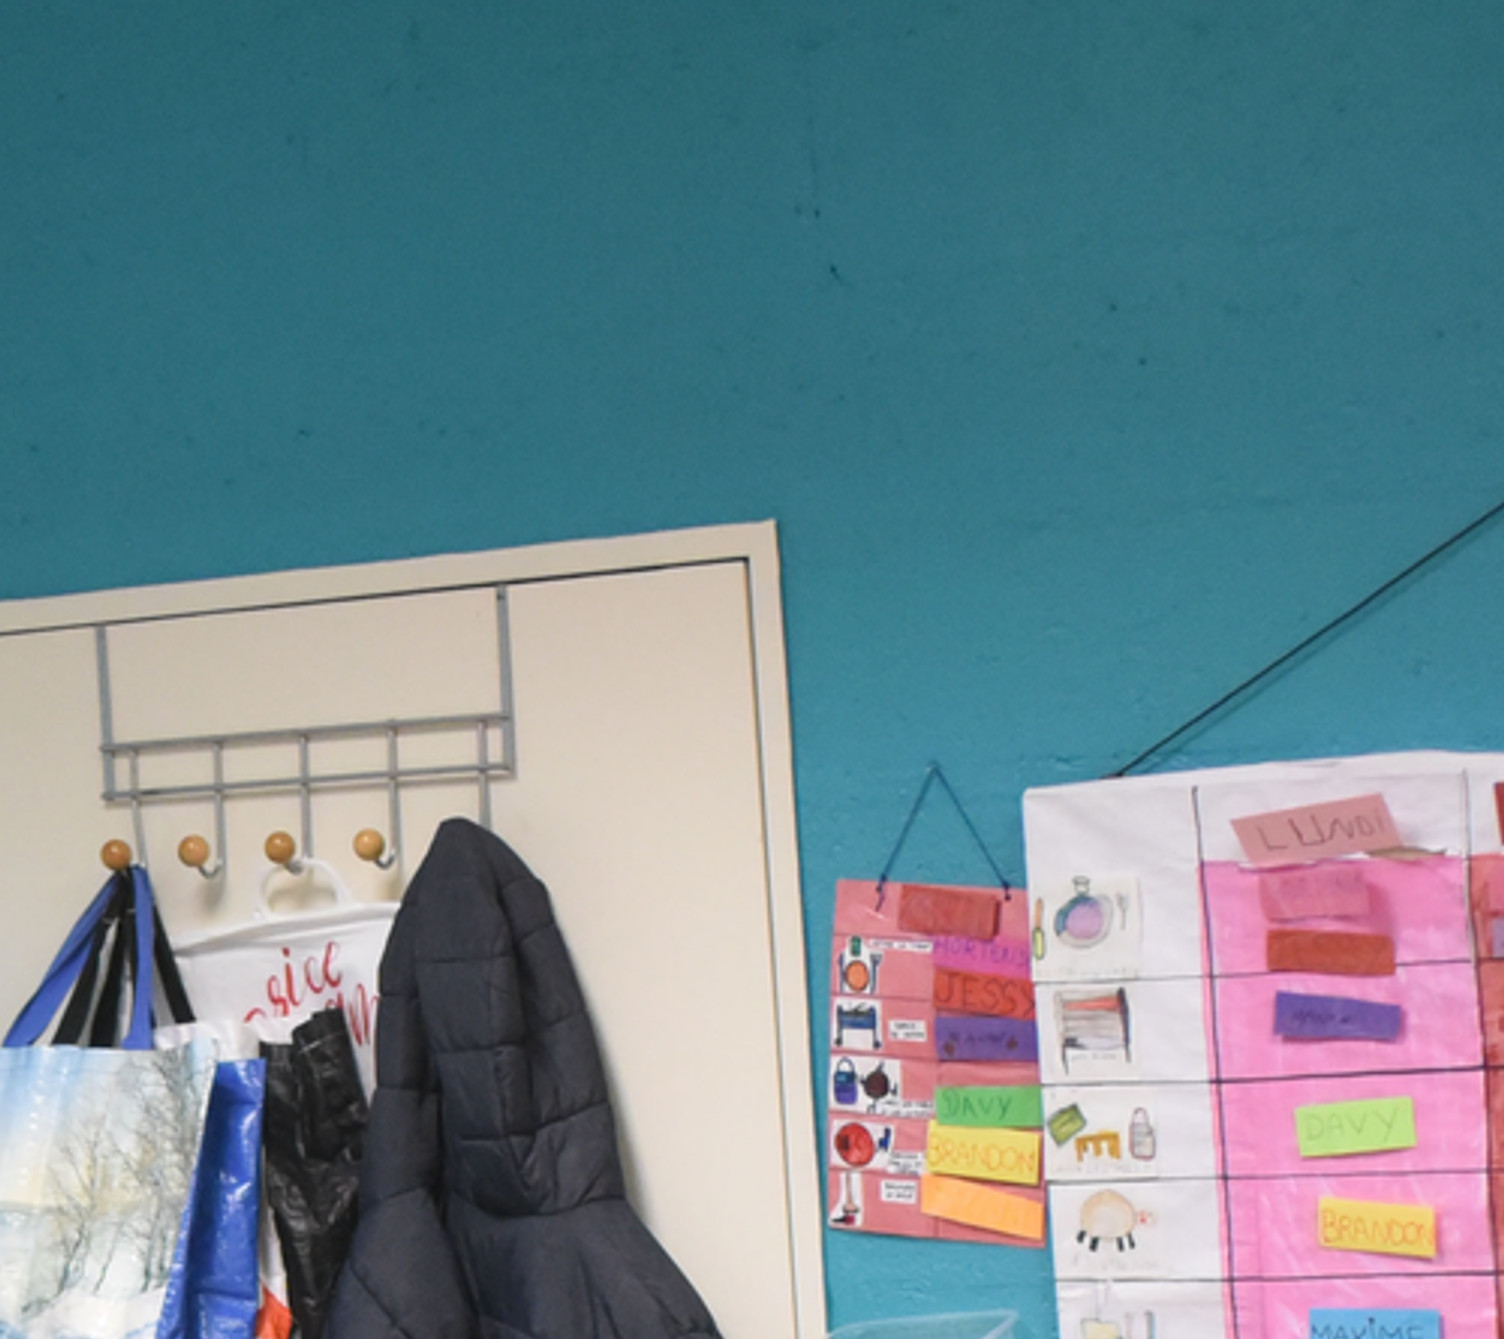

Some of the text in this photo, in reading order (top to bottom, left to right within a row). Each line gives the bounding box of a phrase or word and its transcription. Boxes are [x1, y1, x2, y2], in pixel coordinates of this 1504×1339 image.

[942, 1089, 1013, 1120] DAVY
[1304, 1107, 1400, 1143] DAVY
[929, 1133, 1036, 1172] BRANDON
[1321, 1207, 1435, 1248] BRANDON
